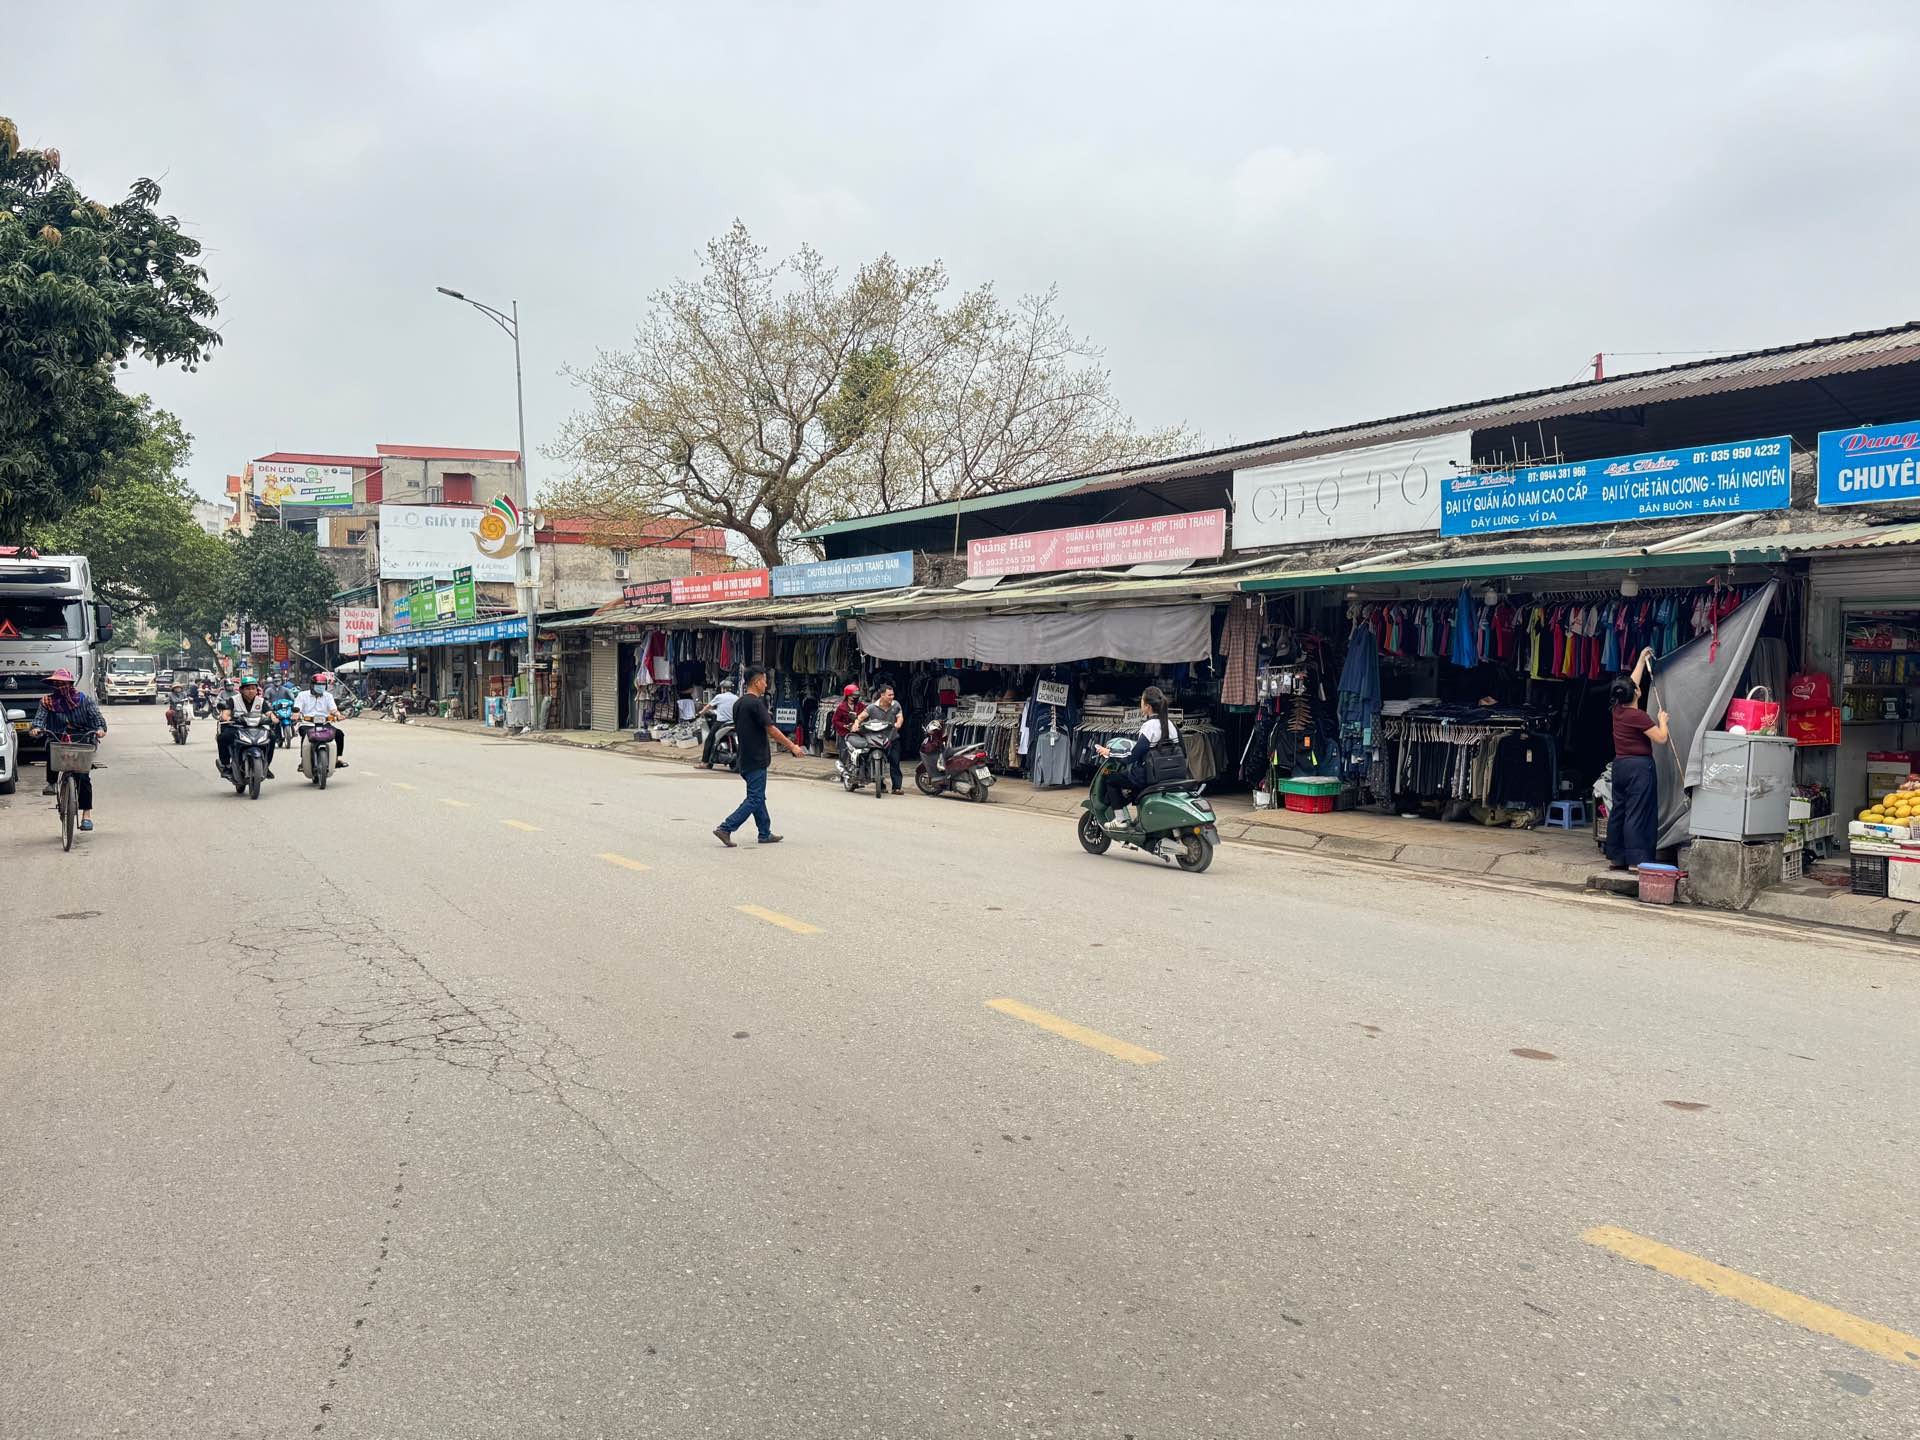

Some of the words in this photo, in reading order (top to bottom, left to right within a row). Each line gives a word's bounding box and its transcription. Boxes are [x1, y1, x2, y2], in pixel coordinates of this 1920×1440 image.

[1693, 452, 1708, 464] ĐT:
[1711, 450, 1730, 462] 035
[1732, 447, 1751, 459] 950
[1754, 444, 1781, 457] 4232
[1528, 472, 1539, 482] ĐT:
[1558, 468, 1571, 479] 381
[1602, 486, 1617, 506] ĐẠI
[1619, 479, 1630, 499] LÝ
[1631, 477, 1649, 498] CHÈ
[1651, 476, 1669, 496] TÂN
[1671, 475, 1709, 495] CƯƠNG
[1718, 468, 1739, 490] THÁI
[1742, 465, 1785, 488] NGUYÊN
[1252, 467, 1344, 526] CHỢ
[1446, 500, 1461, 516] ĐẠI
[1462, 494, 1472, 513] LÝ
[1501, 490, 1516, 509] ÁO
[1518, 489, 1540, 506] NAM
[1542, 487, 1565, 505] CAO
[1567, 480, 1588, 501] CẤP
[1639, 502, 1660, 513] BÁN
[1663, 499, 1692, 511] BUÔN
[1703, 496, 1726, 508] BÁN
[1529, 510, 1540, 522] VÍ
[1541, 511, 1557, 521] DA
[1096, 527, 1112, 539] NAM
[1114, 526, 1127, 537] CAO
[1129, 522, 1144, 535] CẤP
[1188, 514, 1216, 528] TRANG
[1009, 537, 1031, 553] Hậu
[1132, 538, 1141, 548] MI
[1142, 535, 1158, 547] VIỆT
[865, 560, 884, 571] TRANG
[885, 559, 900, 569] NAM
